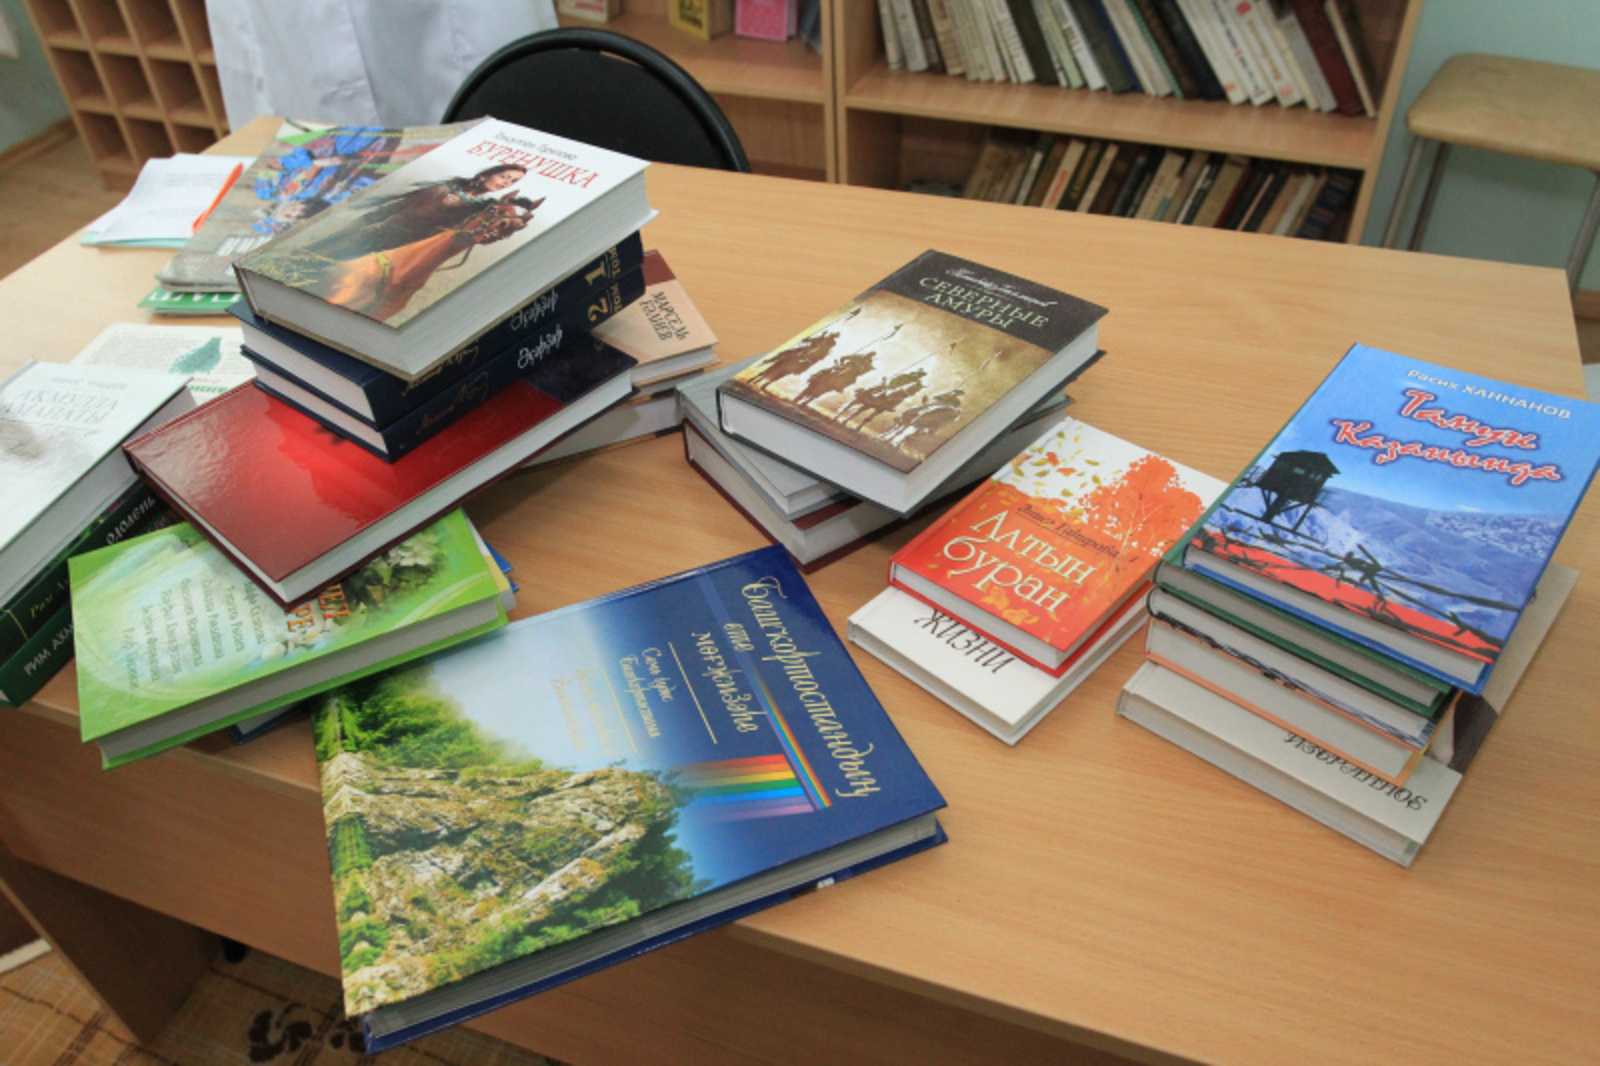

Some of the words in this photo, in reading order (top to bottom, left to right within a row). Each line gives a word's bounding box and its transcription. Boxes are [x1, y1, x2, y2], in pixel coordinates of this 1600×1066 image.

[584, 261, 605, 286] 1
[586, 297, 609, 321] 2
[652, 290, 690, 341] МАРСЕЛЬ
[919, 276, 1050, 328] СЕВЕРНЫЕ
[925, 292, 1014, 330] АМУРЫ
[1461, 385, 1573, 420] ХАННАНОВ
[943, 535, 1071, 614] буран
[913, 608, 1015, 674] ЖИЗНИ
[23, 649, 52, 676] РИМ
